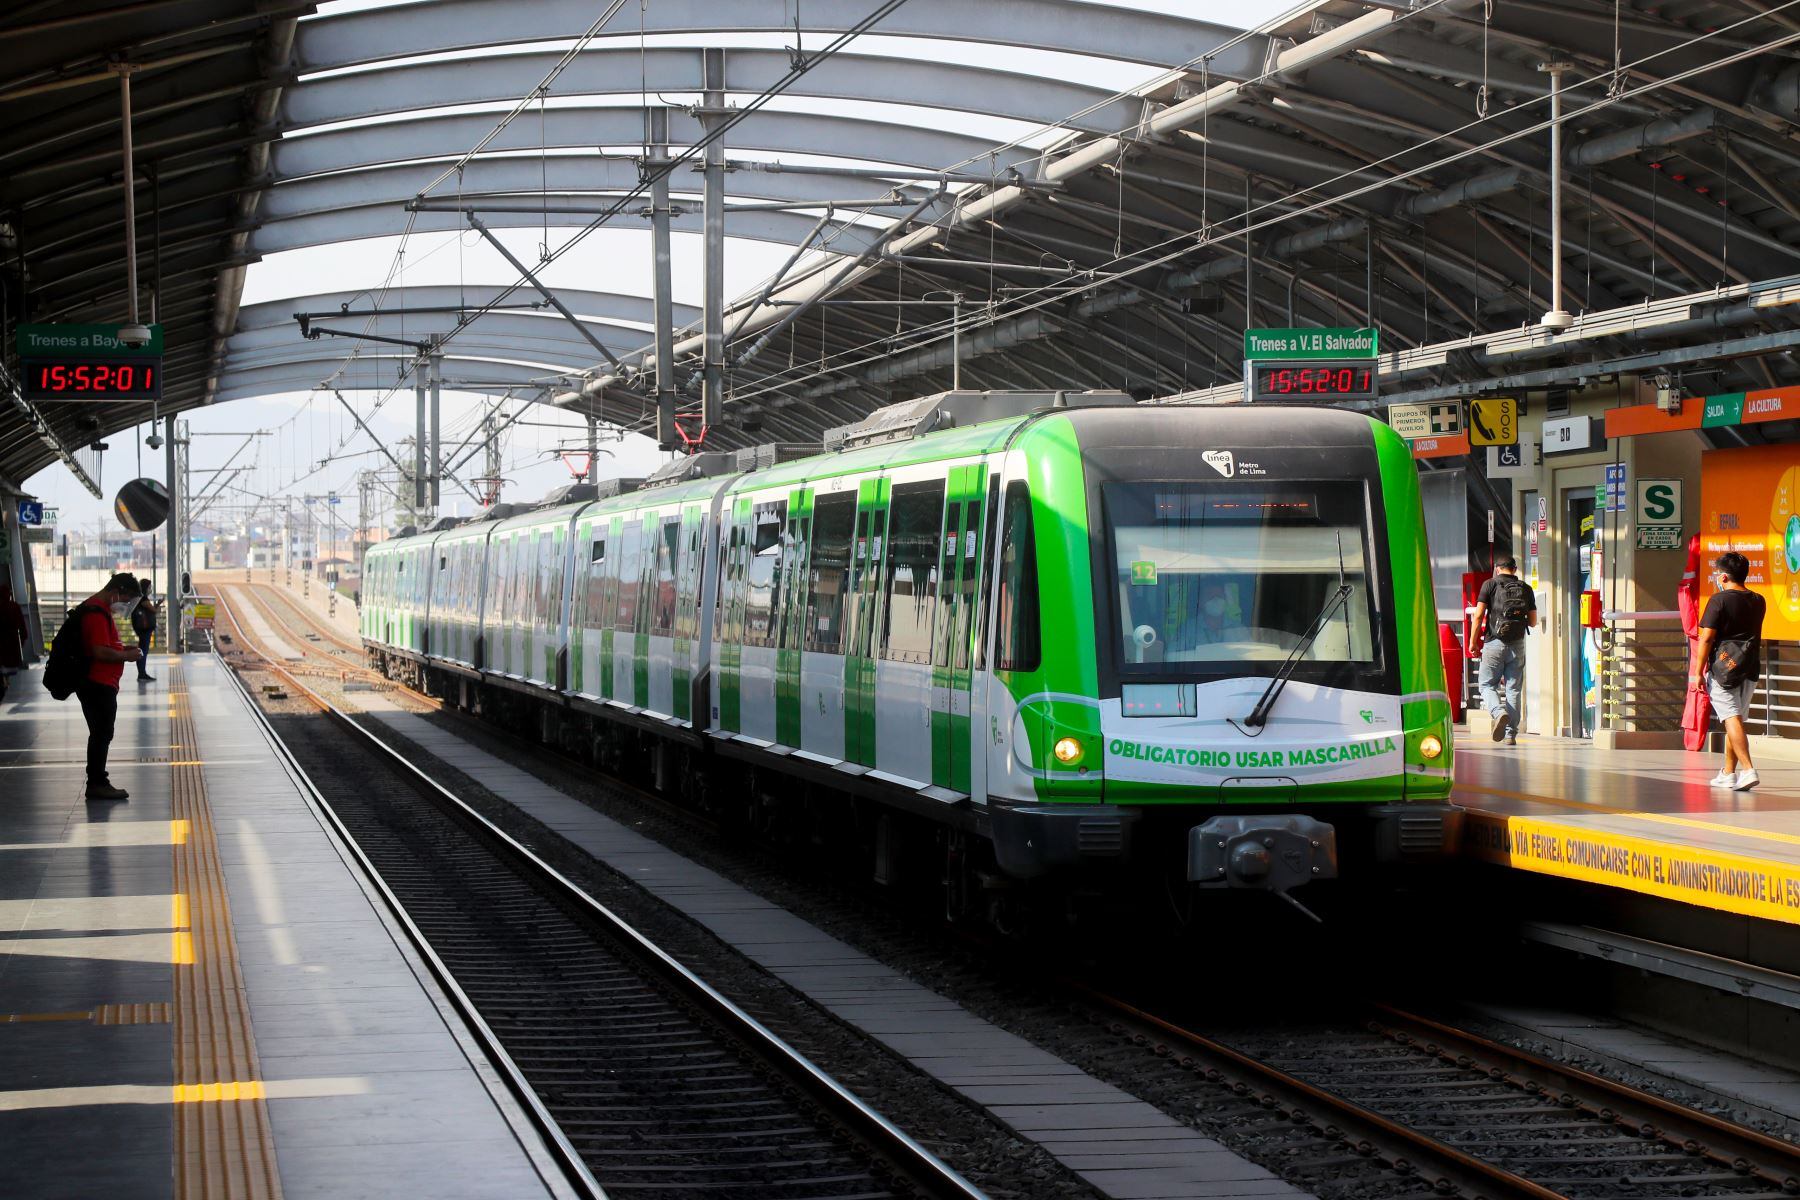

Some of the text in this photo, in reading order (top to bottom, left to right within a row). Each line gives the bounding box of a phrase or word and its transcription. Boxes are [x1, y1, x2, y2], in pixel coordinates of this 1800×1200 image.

[28, 334, 77, 346] Trenes
[80, 336, 89, 346] a
[1250, 336, 1287, 351] Trenes
[1289, 339, 1297, 351] a
[1325, 334, 1373, 351] Salvador
[41, 365, 152, 391] 15:52:01
[1269, 369, 1371, 393] 15:52:01
[1706, 404, 1725, 418] SALIDA
[1748, 398, 1782, 413] LA CULTURA
[1396, 417, 1426, 425] PRIMEROS
[1398, 424, 1425, 432] AUXILIOS
[1224, 463, 1232, 474] 1
[1644, 485, 1675, 519] S
[1135, 565, 1155, 579] 12
[1109, 736, 1396, 768] OBLIGATORIO USAR MASCARILLA
[1515, 826, 1528, 857] VÍA
[1532, 829, 1565, 867] FÉRREA,
[1566, 838, 1629, 876] COMUNICARSE
[1631, 851, 1650, 880] CON
[1654, 856, 1665, 884] EL
[1668, 859, 1751, 899] ADMINISTRADOR
[1752, 872, 1766, 902] DE
[1769, 875, 1784, 905] LA
